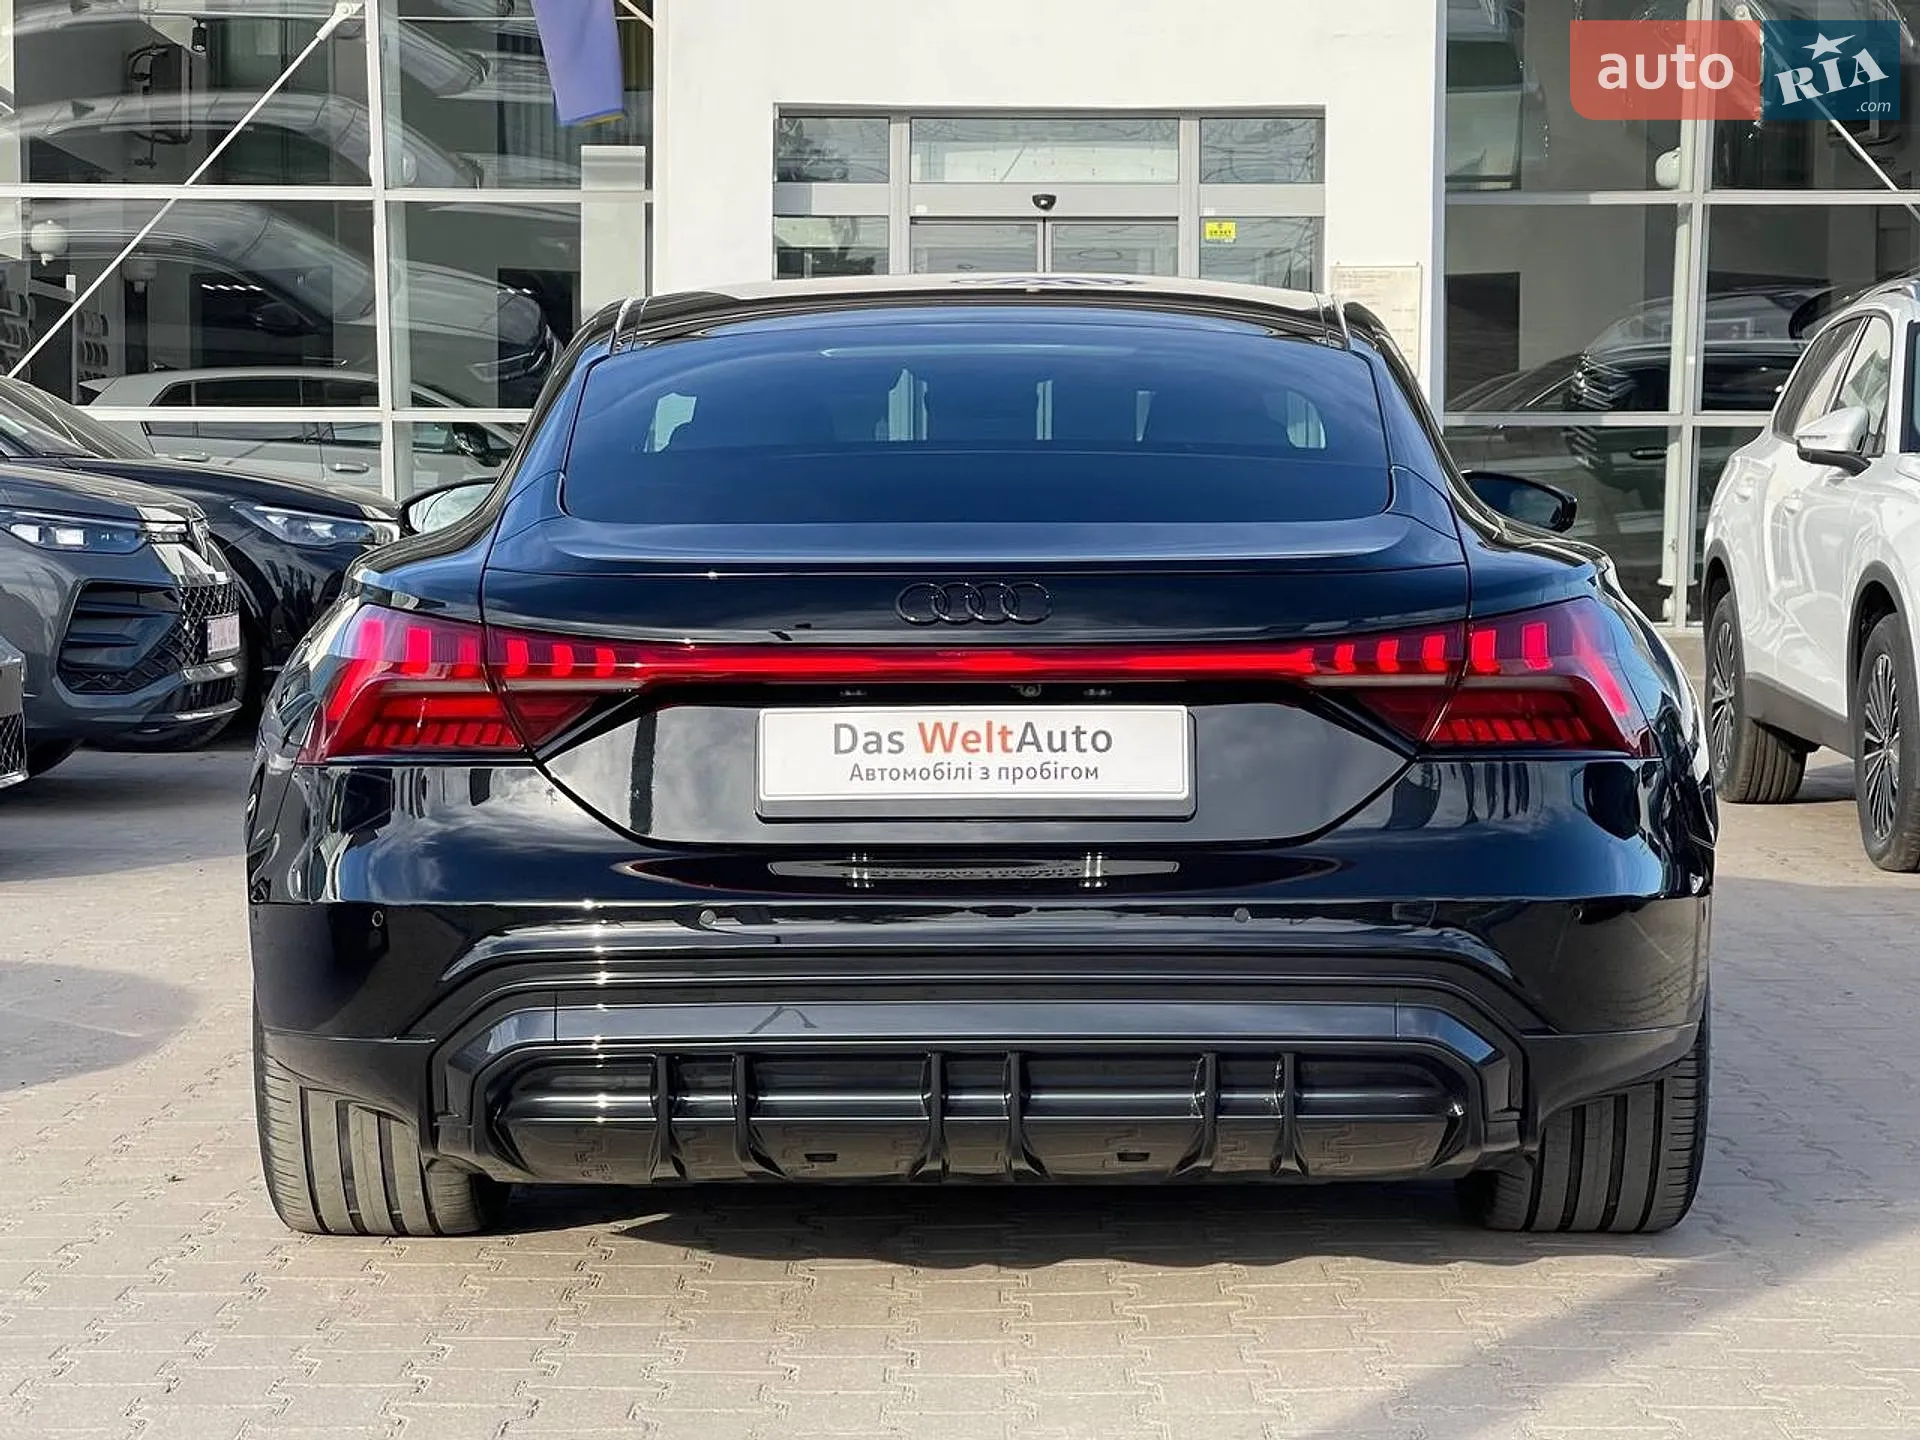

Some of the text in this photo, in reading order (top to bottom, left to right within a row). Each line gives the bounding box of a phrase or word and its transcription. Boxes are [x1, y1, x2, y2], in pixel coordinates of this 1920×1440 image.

[834, 719, 1113, 755] Das WeltAuto
[849, 760, 1100, 785] Автомобілі з пробігом
